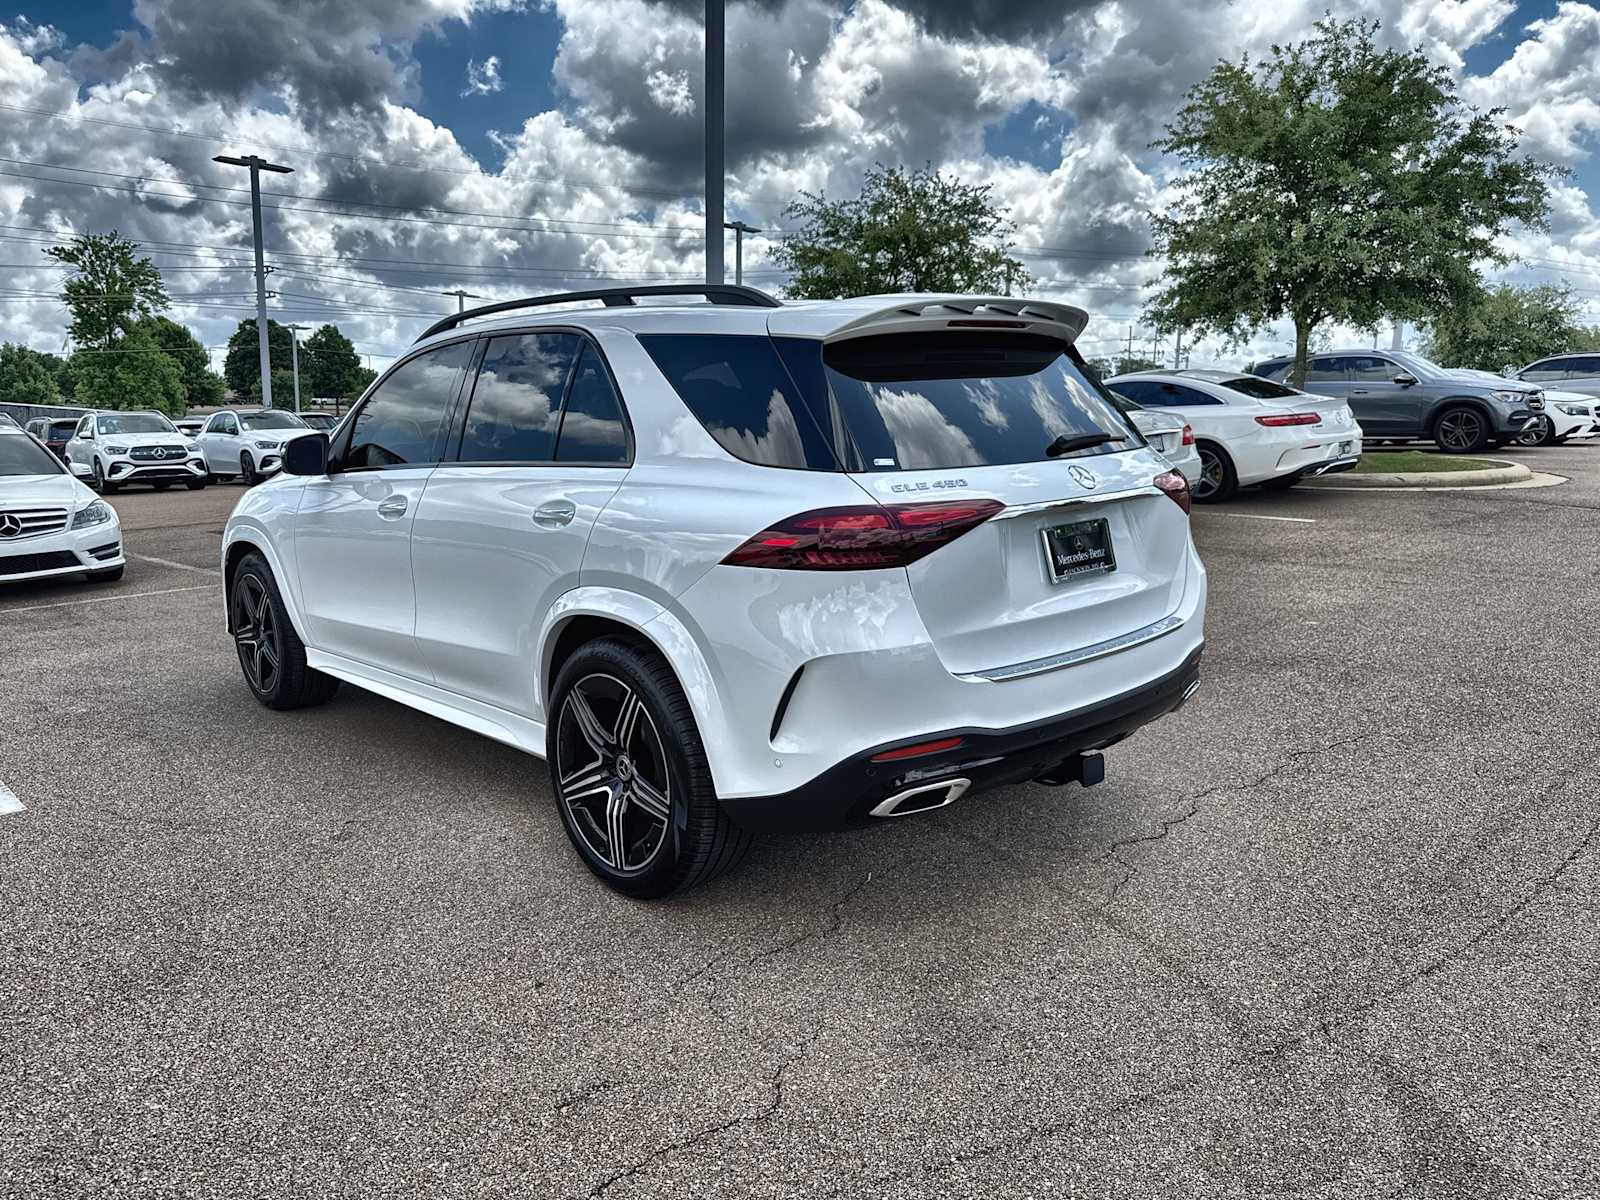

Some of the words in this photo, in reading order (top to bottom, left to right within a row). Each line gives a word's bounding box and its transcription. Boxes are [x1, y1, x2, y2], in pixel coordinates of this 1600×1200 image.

[890, 481, 930, 493] GLE
[932, 478, 968, 489] 450
[1056, 548, 1105, 566] Mercedes-Benz
